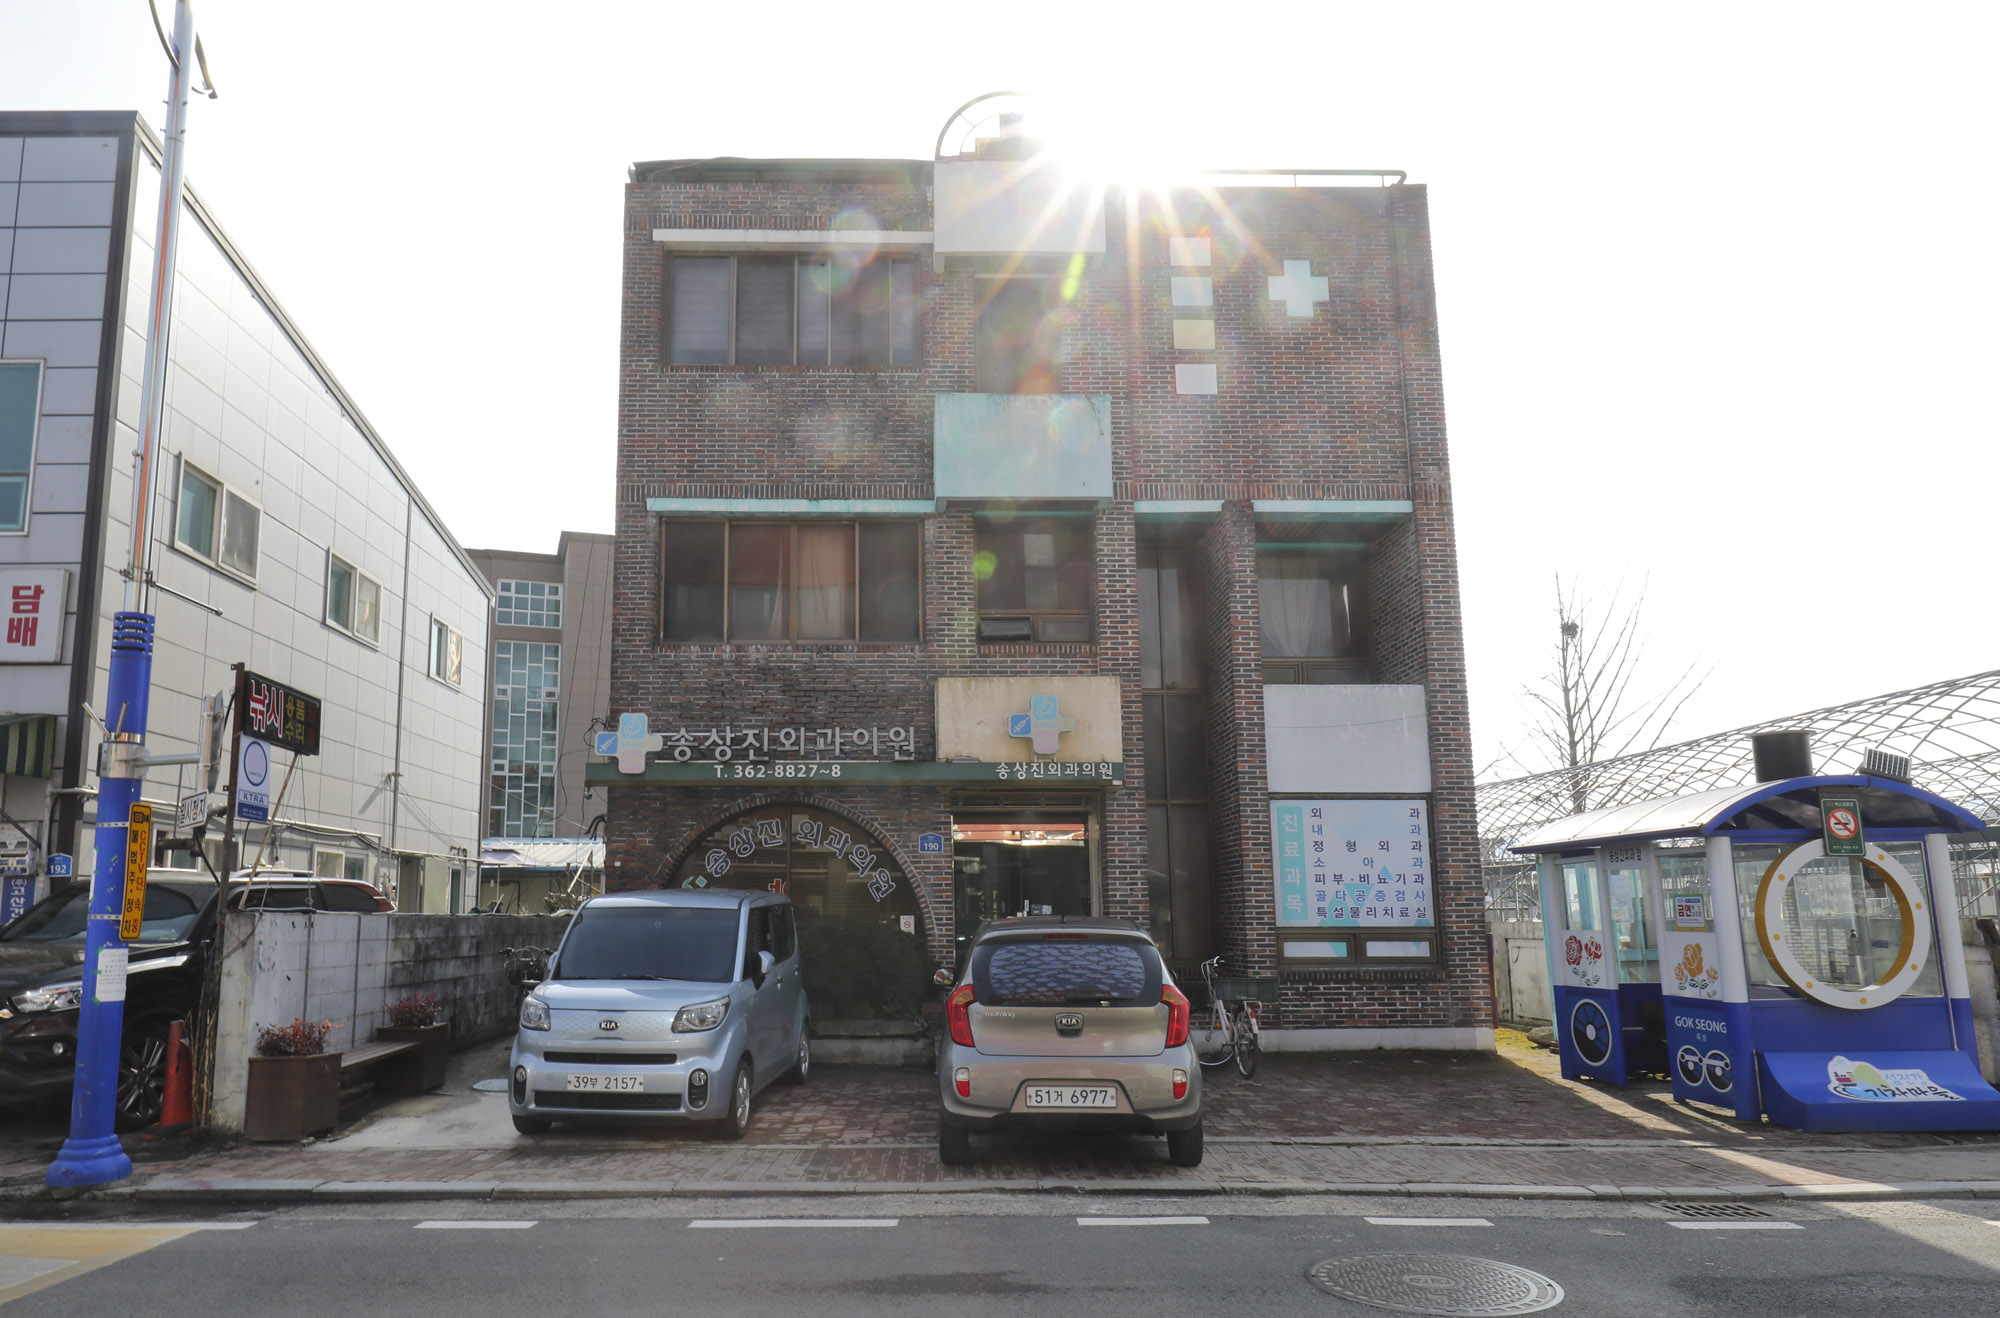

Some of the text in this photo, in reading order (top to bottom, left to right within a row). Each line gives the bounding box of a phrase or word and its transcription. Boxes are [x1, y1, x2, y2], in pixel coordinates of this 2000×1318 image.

[7, 584, 44, 646] 담배
[250, 679, 284, 738] 낚시
[714, 764, 841, 778] T. 362-8827~8
[995, 762, 1112, 779] 송상진외과의원
[924, 842, 939, 850] 190
[50, 865, 67, 874] 192
[1281, 813, 1305, 913] 진료과목
[1677, 904, 1692, 917] 금연
[601, 1021, 616, 1029] KIA
[1675, 1016, 1727, 1033] GOK SEONG
[604, 1076, 637, 1089] 2157
[1035, 1089, 1108, 1104] 51거 6977
[1864, 1084, 1960, 1100] 기차마을
